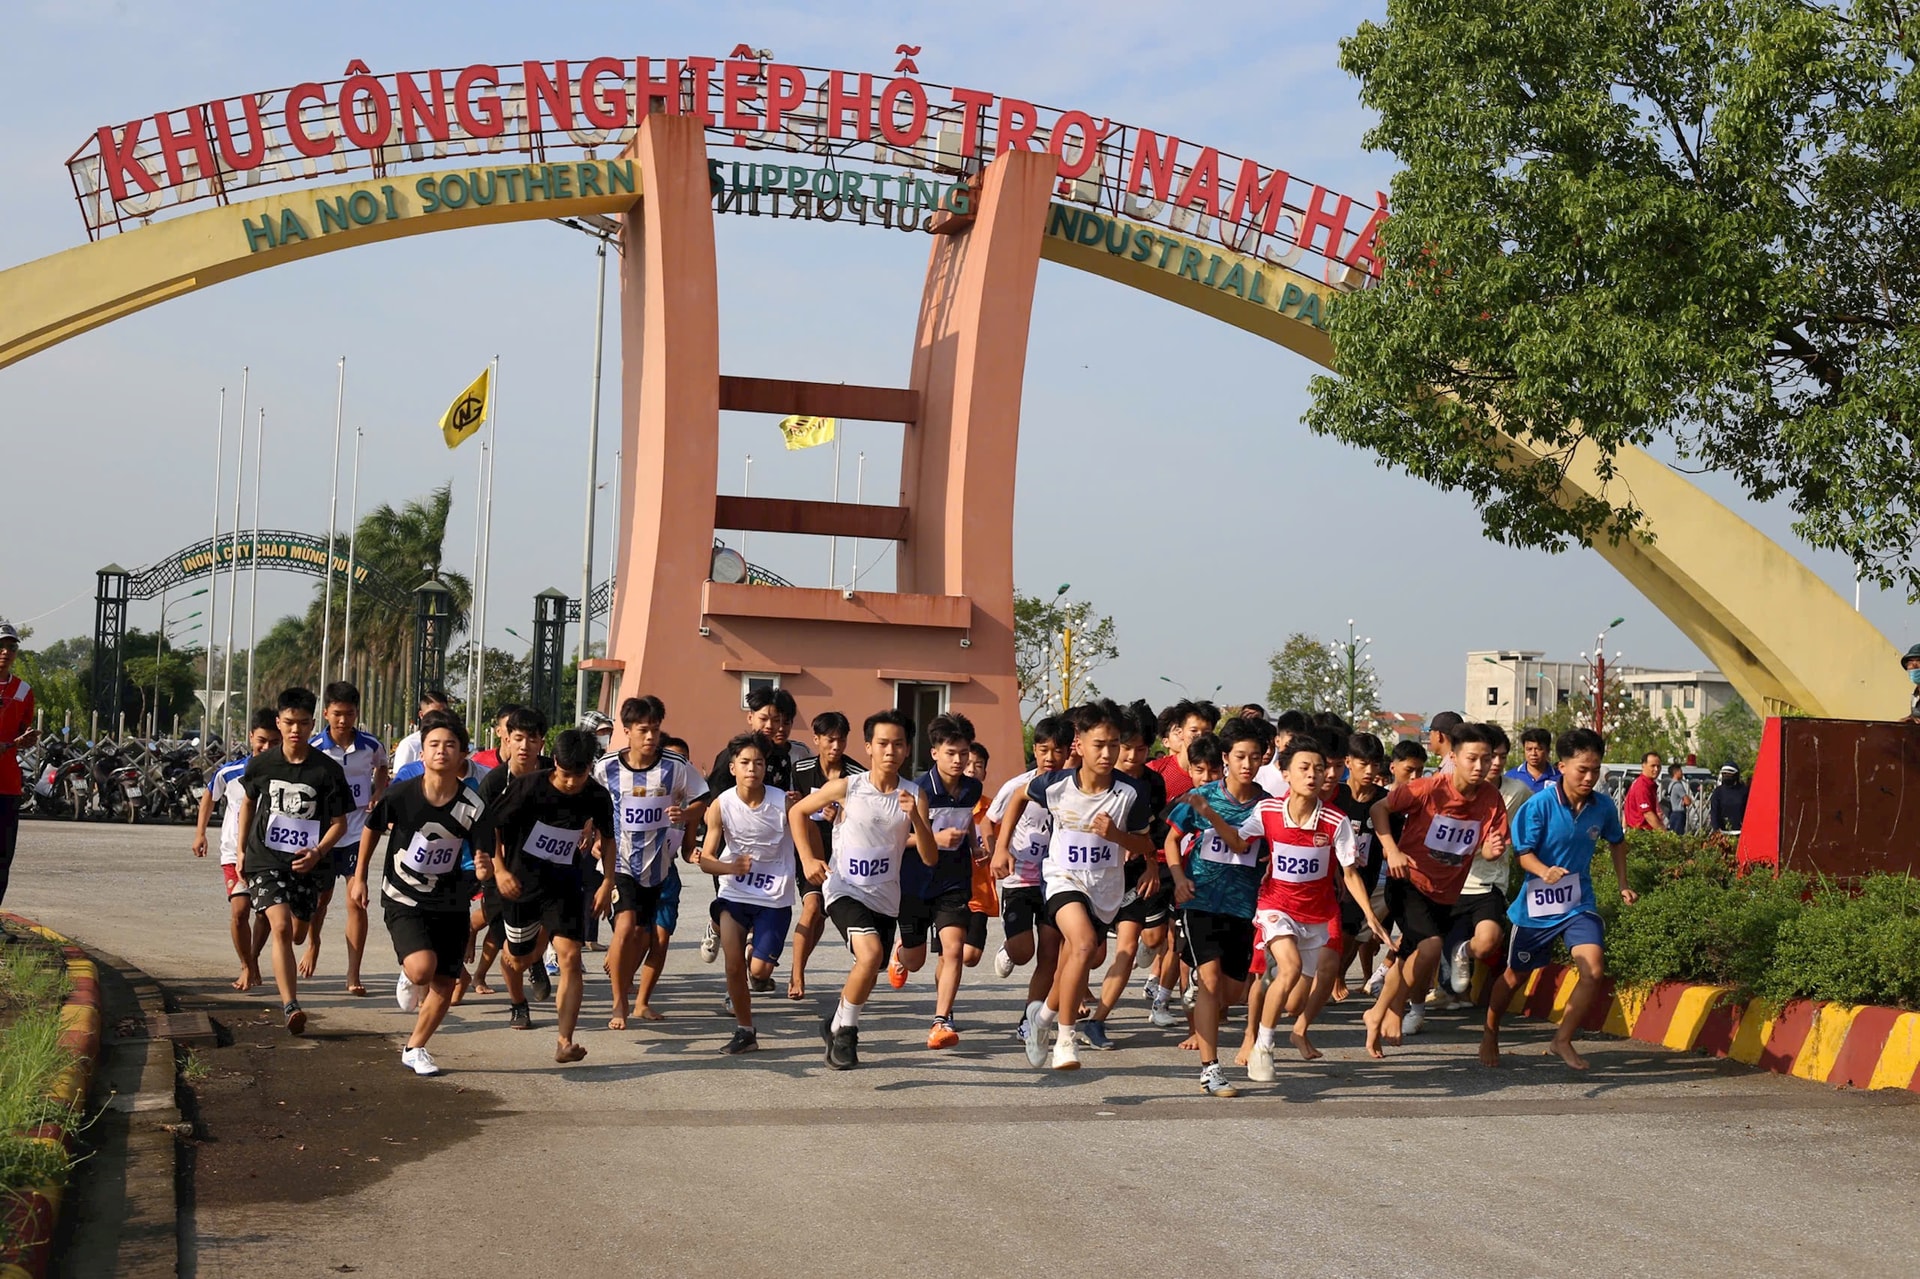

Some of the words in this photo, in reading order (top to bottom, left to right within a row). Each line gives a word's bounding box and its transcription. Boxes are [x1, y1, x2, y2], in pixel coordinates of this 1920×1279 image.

[97, 93, 265, 200] KHU
[284, 59, 504, 157] CÔNG
[523, 44, 807, 147] NGHIỆP
[828, 44, 928, 148] HỖ
[952, 87, 1111, 194] TRỢ
[1127, 128, 1290, 235] NAM
[1298, 184, 1391, 279] HÀ
[242, 208, 308, 253] HA
[317, 185, 399, 233] NOI
[416, 159, 635, 214] SOUTHERN
[708, 157, 969, 215] SUPPORTING
[1045, 203, 1265, 305] NDUSTRIAL
[1278, 282, 1331, 331] PA
[625, 807, 662, 824] 5200
[270, 826, 309, 847] 5233
[1436, 824, 1475, 845] 5118
[414, 846, 453, 865] 5136
[535, 834, 574, 857] 5038
[1068, 845, 1111, 864] 5154
[849, 858, 890, 877] 5025
[1277, 855, 1320, 875] 5236
[1535, 885, 1574, 906] 5007
